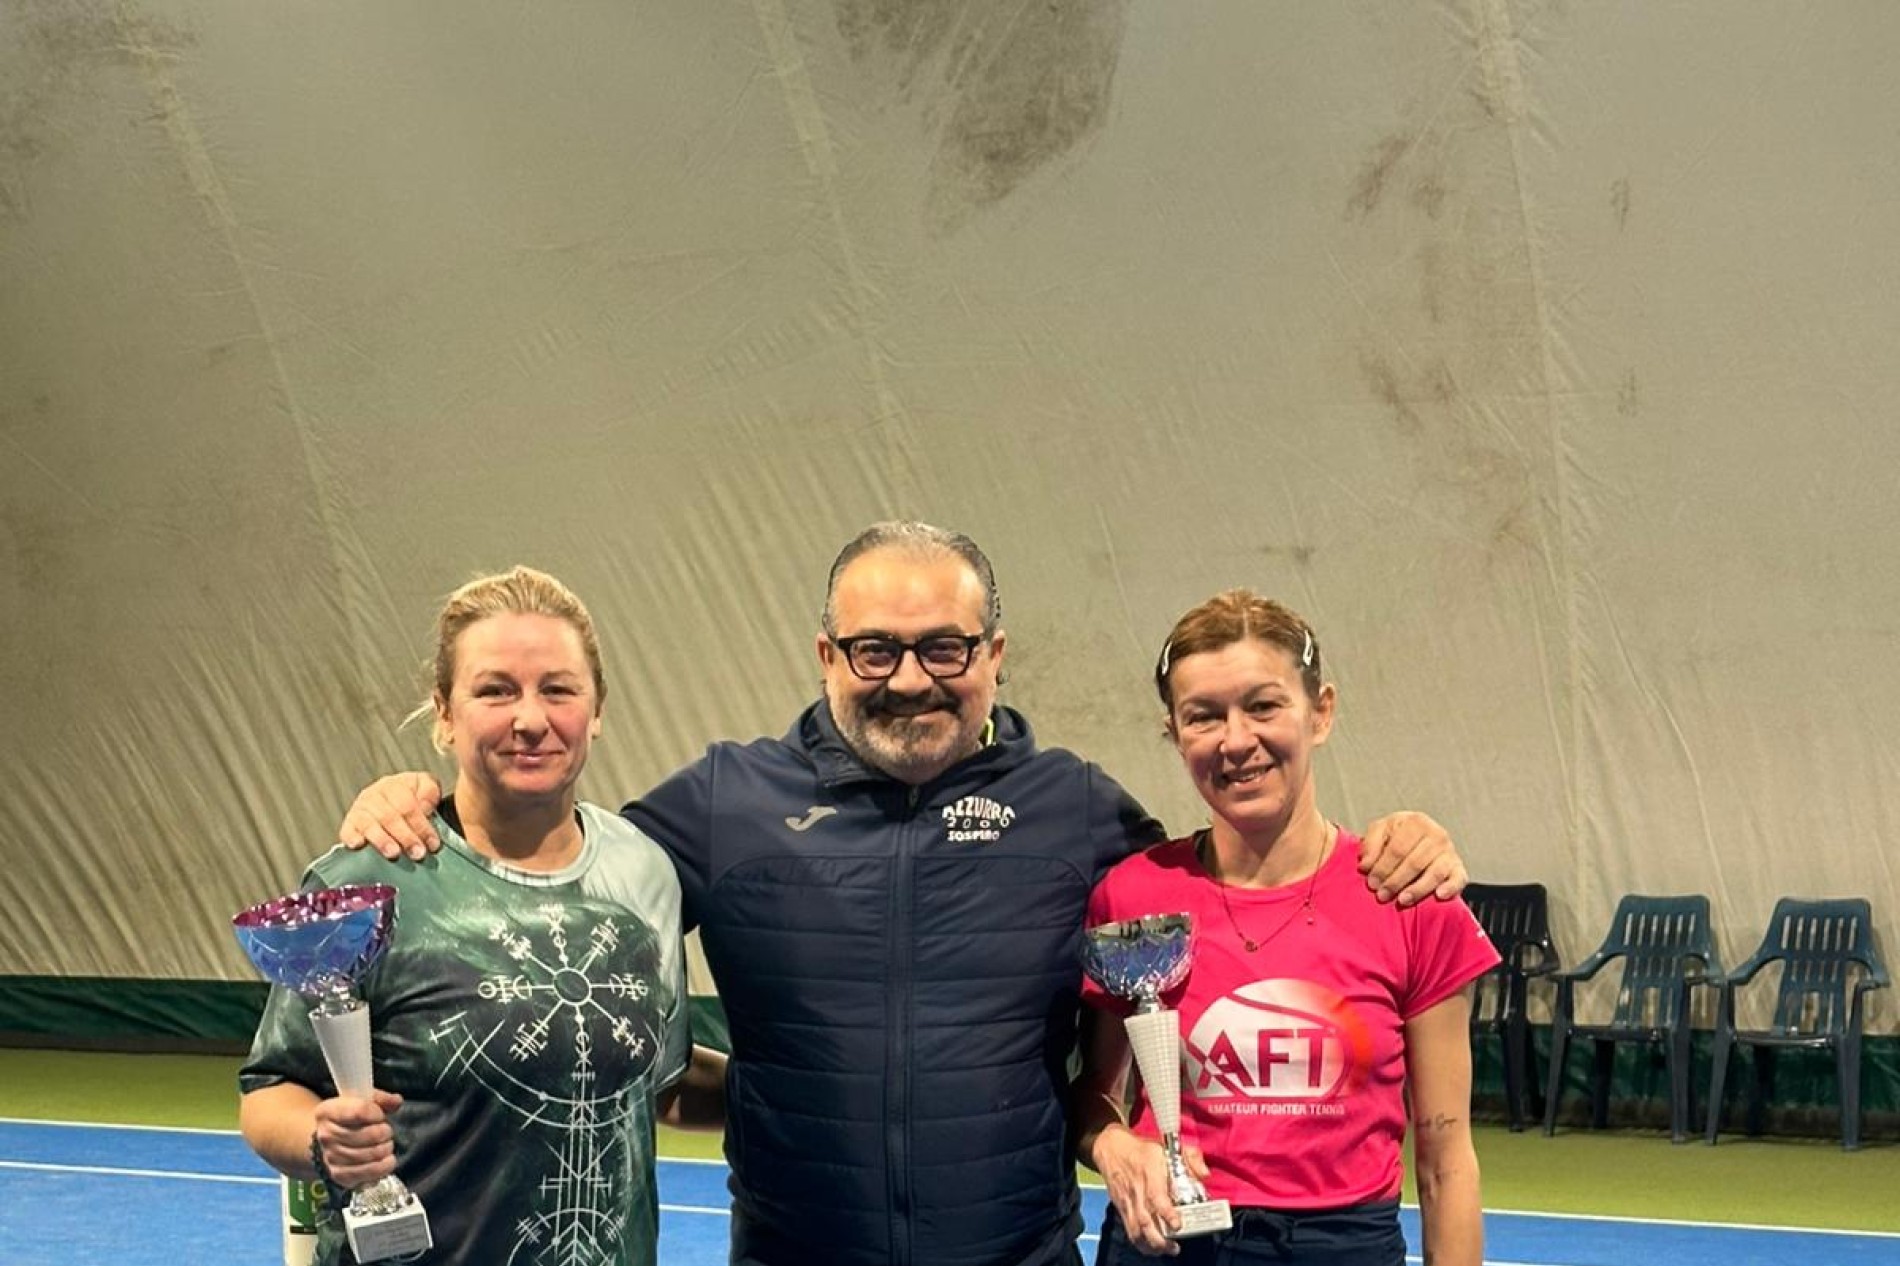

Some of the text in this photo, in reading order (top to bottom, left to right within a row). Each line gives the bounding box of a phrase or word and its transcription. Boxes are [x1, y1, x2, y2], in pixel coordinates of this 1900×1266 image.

[941, 795, 1016, 819] AZZURRA
[946, 829, 1000, 841] SOSPIRO
[1197, 1028, 1336, 1090] AFT
[1207, 1102, 1258, 1114] AMATEUR
[1261, 1103, 1306, 1115] FIGHTER
